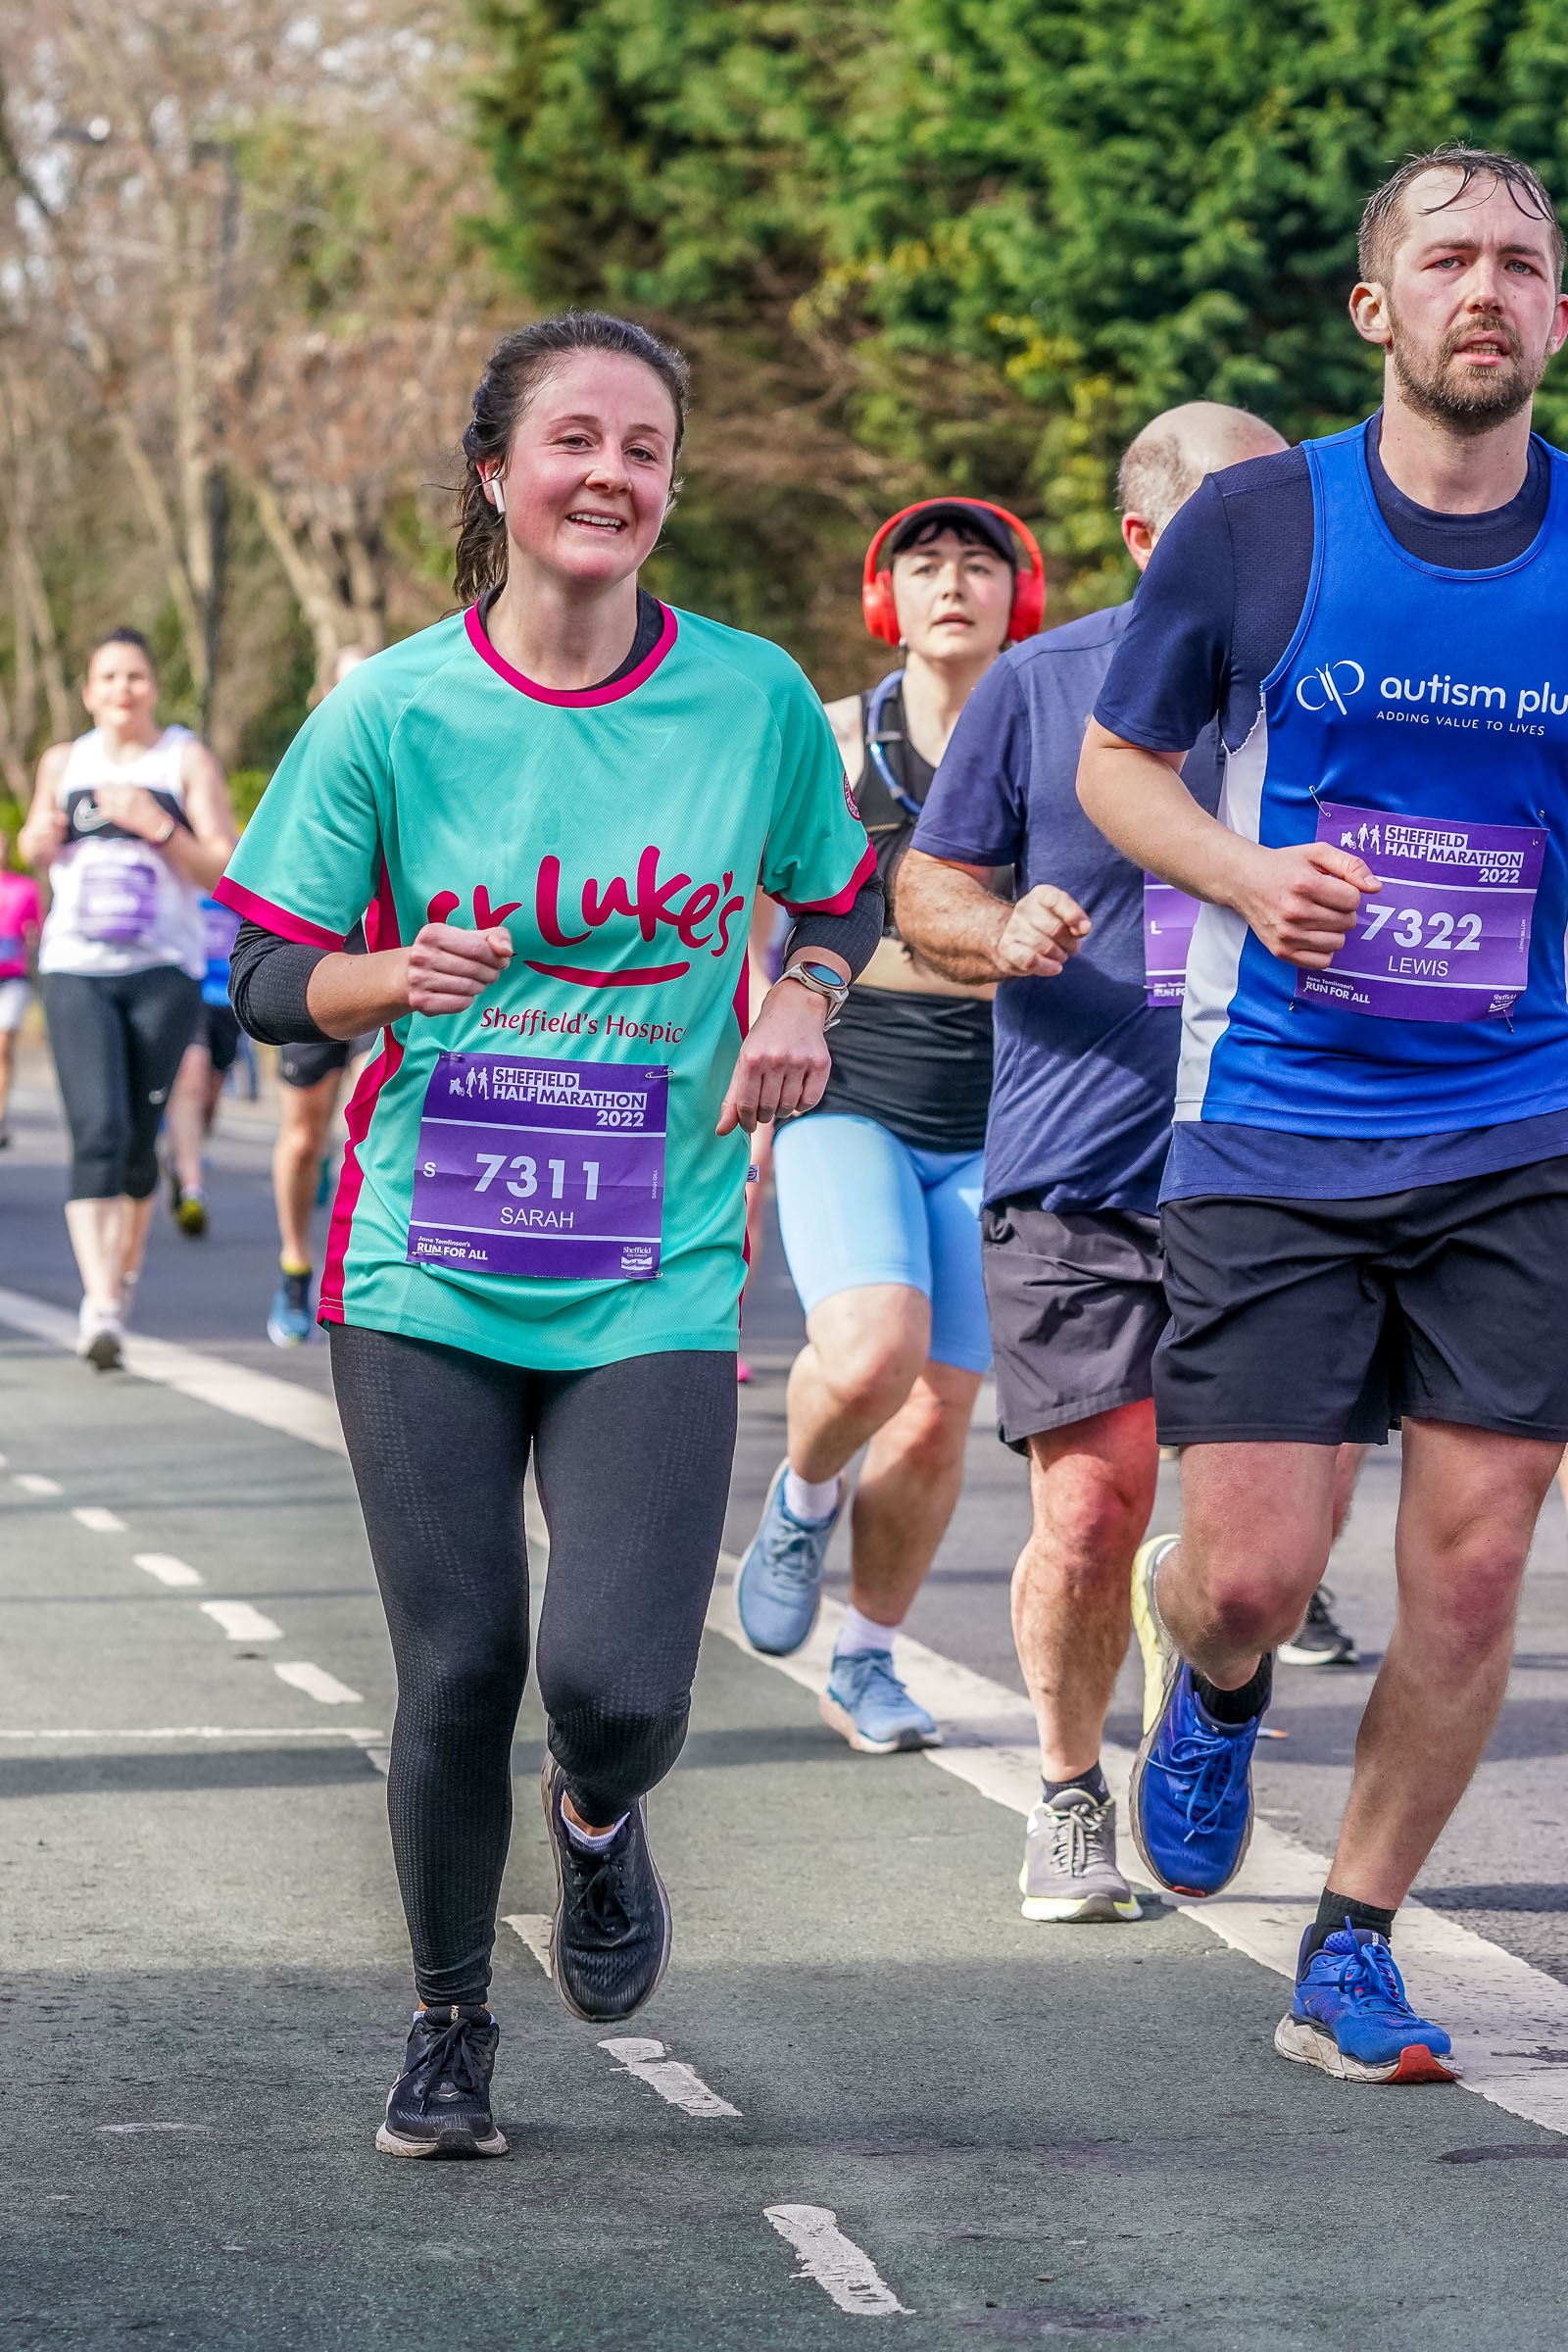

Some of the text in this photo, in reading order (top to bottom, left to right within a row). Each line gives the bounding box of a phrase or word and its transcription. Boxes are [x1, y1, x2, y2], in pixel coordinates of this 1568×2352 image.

[1380, 673, 1506, 710] autism
[1376, 710, 1545, 736] ADDING VALUE TO LIVES
[1386, 826, 1466, 848] SHEFFIELD
[1385, 842, 1522, 867] HALF MARATHON
[1478, 867, 1520, 884] 2022
[535, 845, 745, 957] Luke's
[1150, 919, 1162, 935] L
[1361, 903, 1483, 951] 7322
[1388, 955, 1449, 977] LEWIS
[1306, 981, 1371, 1004] RUN FOR ALL
[480, 1007, 688, 1045] Sheffield's Hospic
[493, 1067, 578, 1089] SHEFFIELD
[493, 1085, 646, 1109] HALF MARATHON
[596, 1110, 645, 1127] 2022
[422, 1161, 436, 1178] S
[474, 1152, 600, 1200] 7311
[500, 1206, 574, 1229] SARAH
[416, 1243, 488, 1260] RUN FOR ALL
